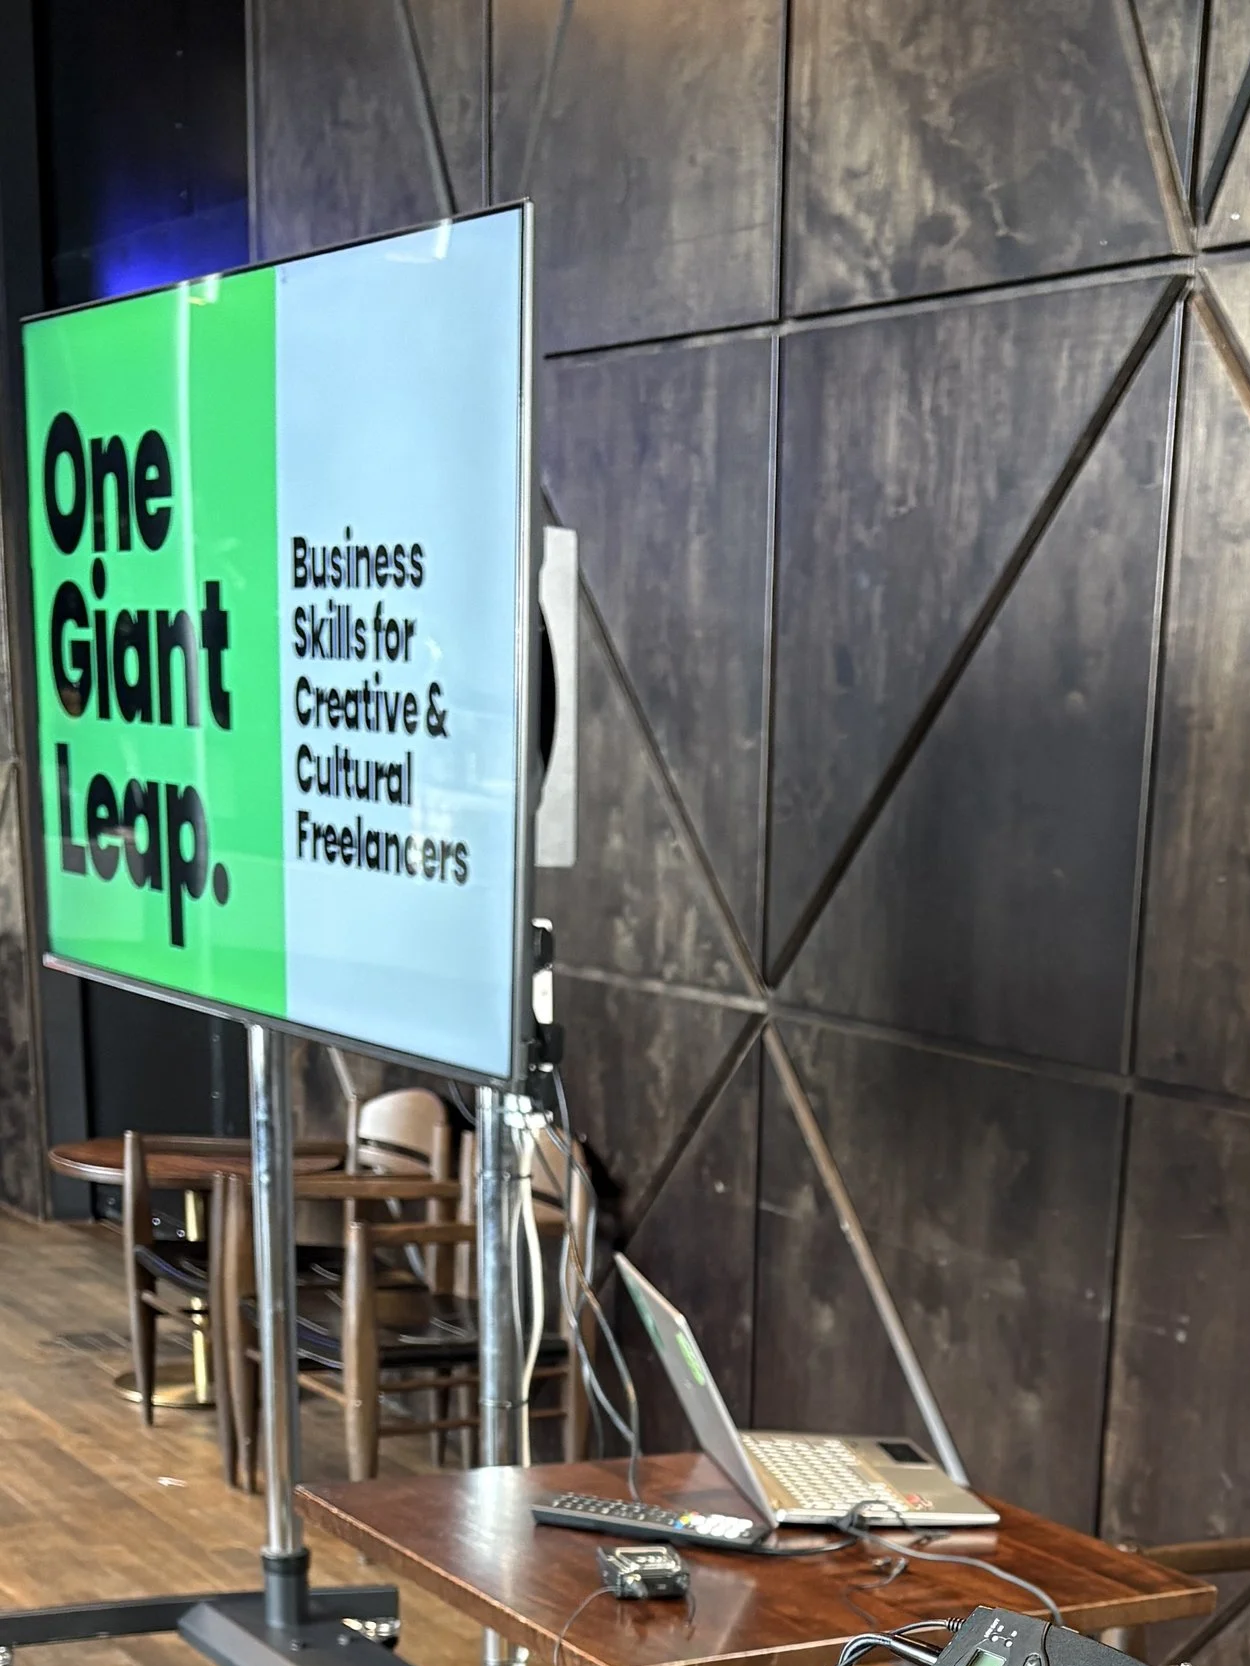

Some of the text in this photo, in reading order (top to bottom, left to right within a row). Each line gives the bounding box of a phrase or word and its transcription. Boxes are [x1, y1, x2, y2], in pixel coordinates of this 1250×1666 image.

[44, 411, 173, 556] One
[291, 527, 426, 591] Business
[51, 557, 231, 732] Giant
[293, 599, 416, 663] Skills for
[294, 676, 448, 739] Creative &
[294, 744, 413, 806] Cultural
[56, 741, 231, 949] Leap.
[295, 810, 470, 885] Freelancers
